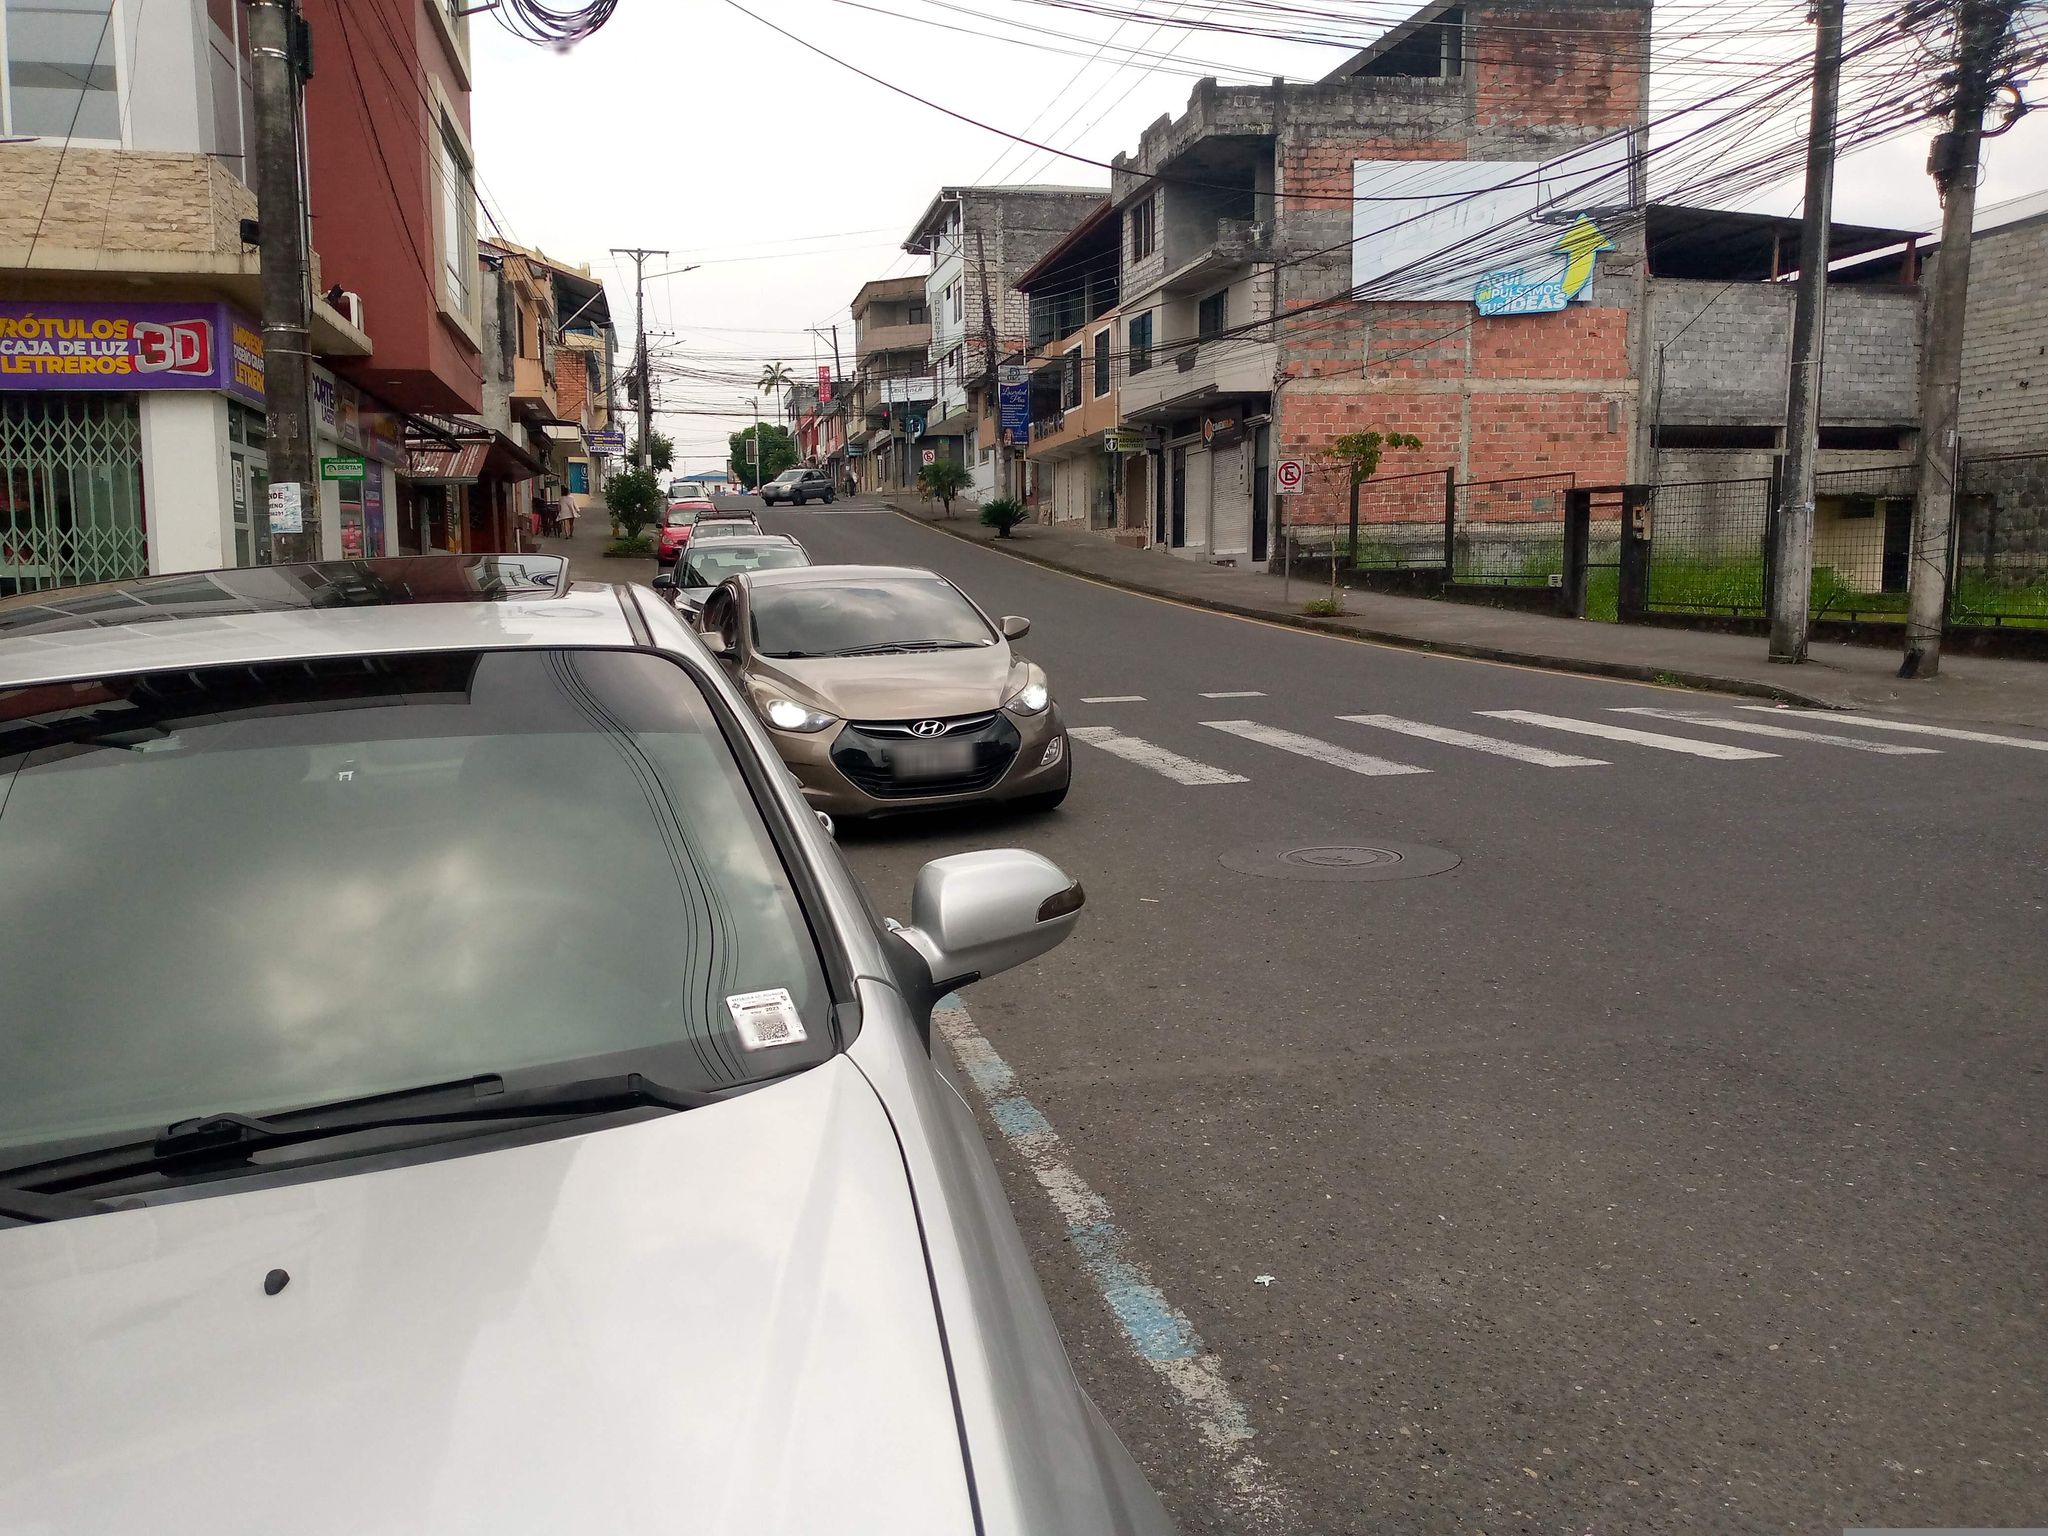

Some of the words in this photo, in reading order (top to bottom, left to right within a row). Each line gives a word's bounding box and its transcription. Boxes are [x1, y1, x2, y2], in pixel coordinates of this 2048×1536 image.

[1503, 294, 1566, 312] IDEAS
[0, 313, 130, 339] RÓTULOS
[0, 340, 55, 356] CAJA
[58, 341, 87, 356] DE
[90, 341, 129, 356] LUZ
[132, 321, 200, 374] 3D
[1, 356, 133, 374] LETREROS
